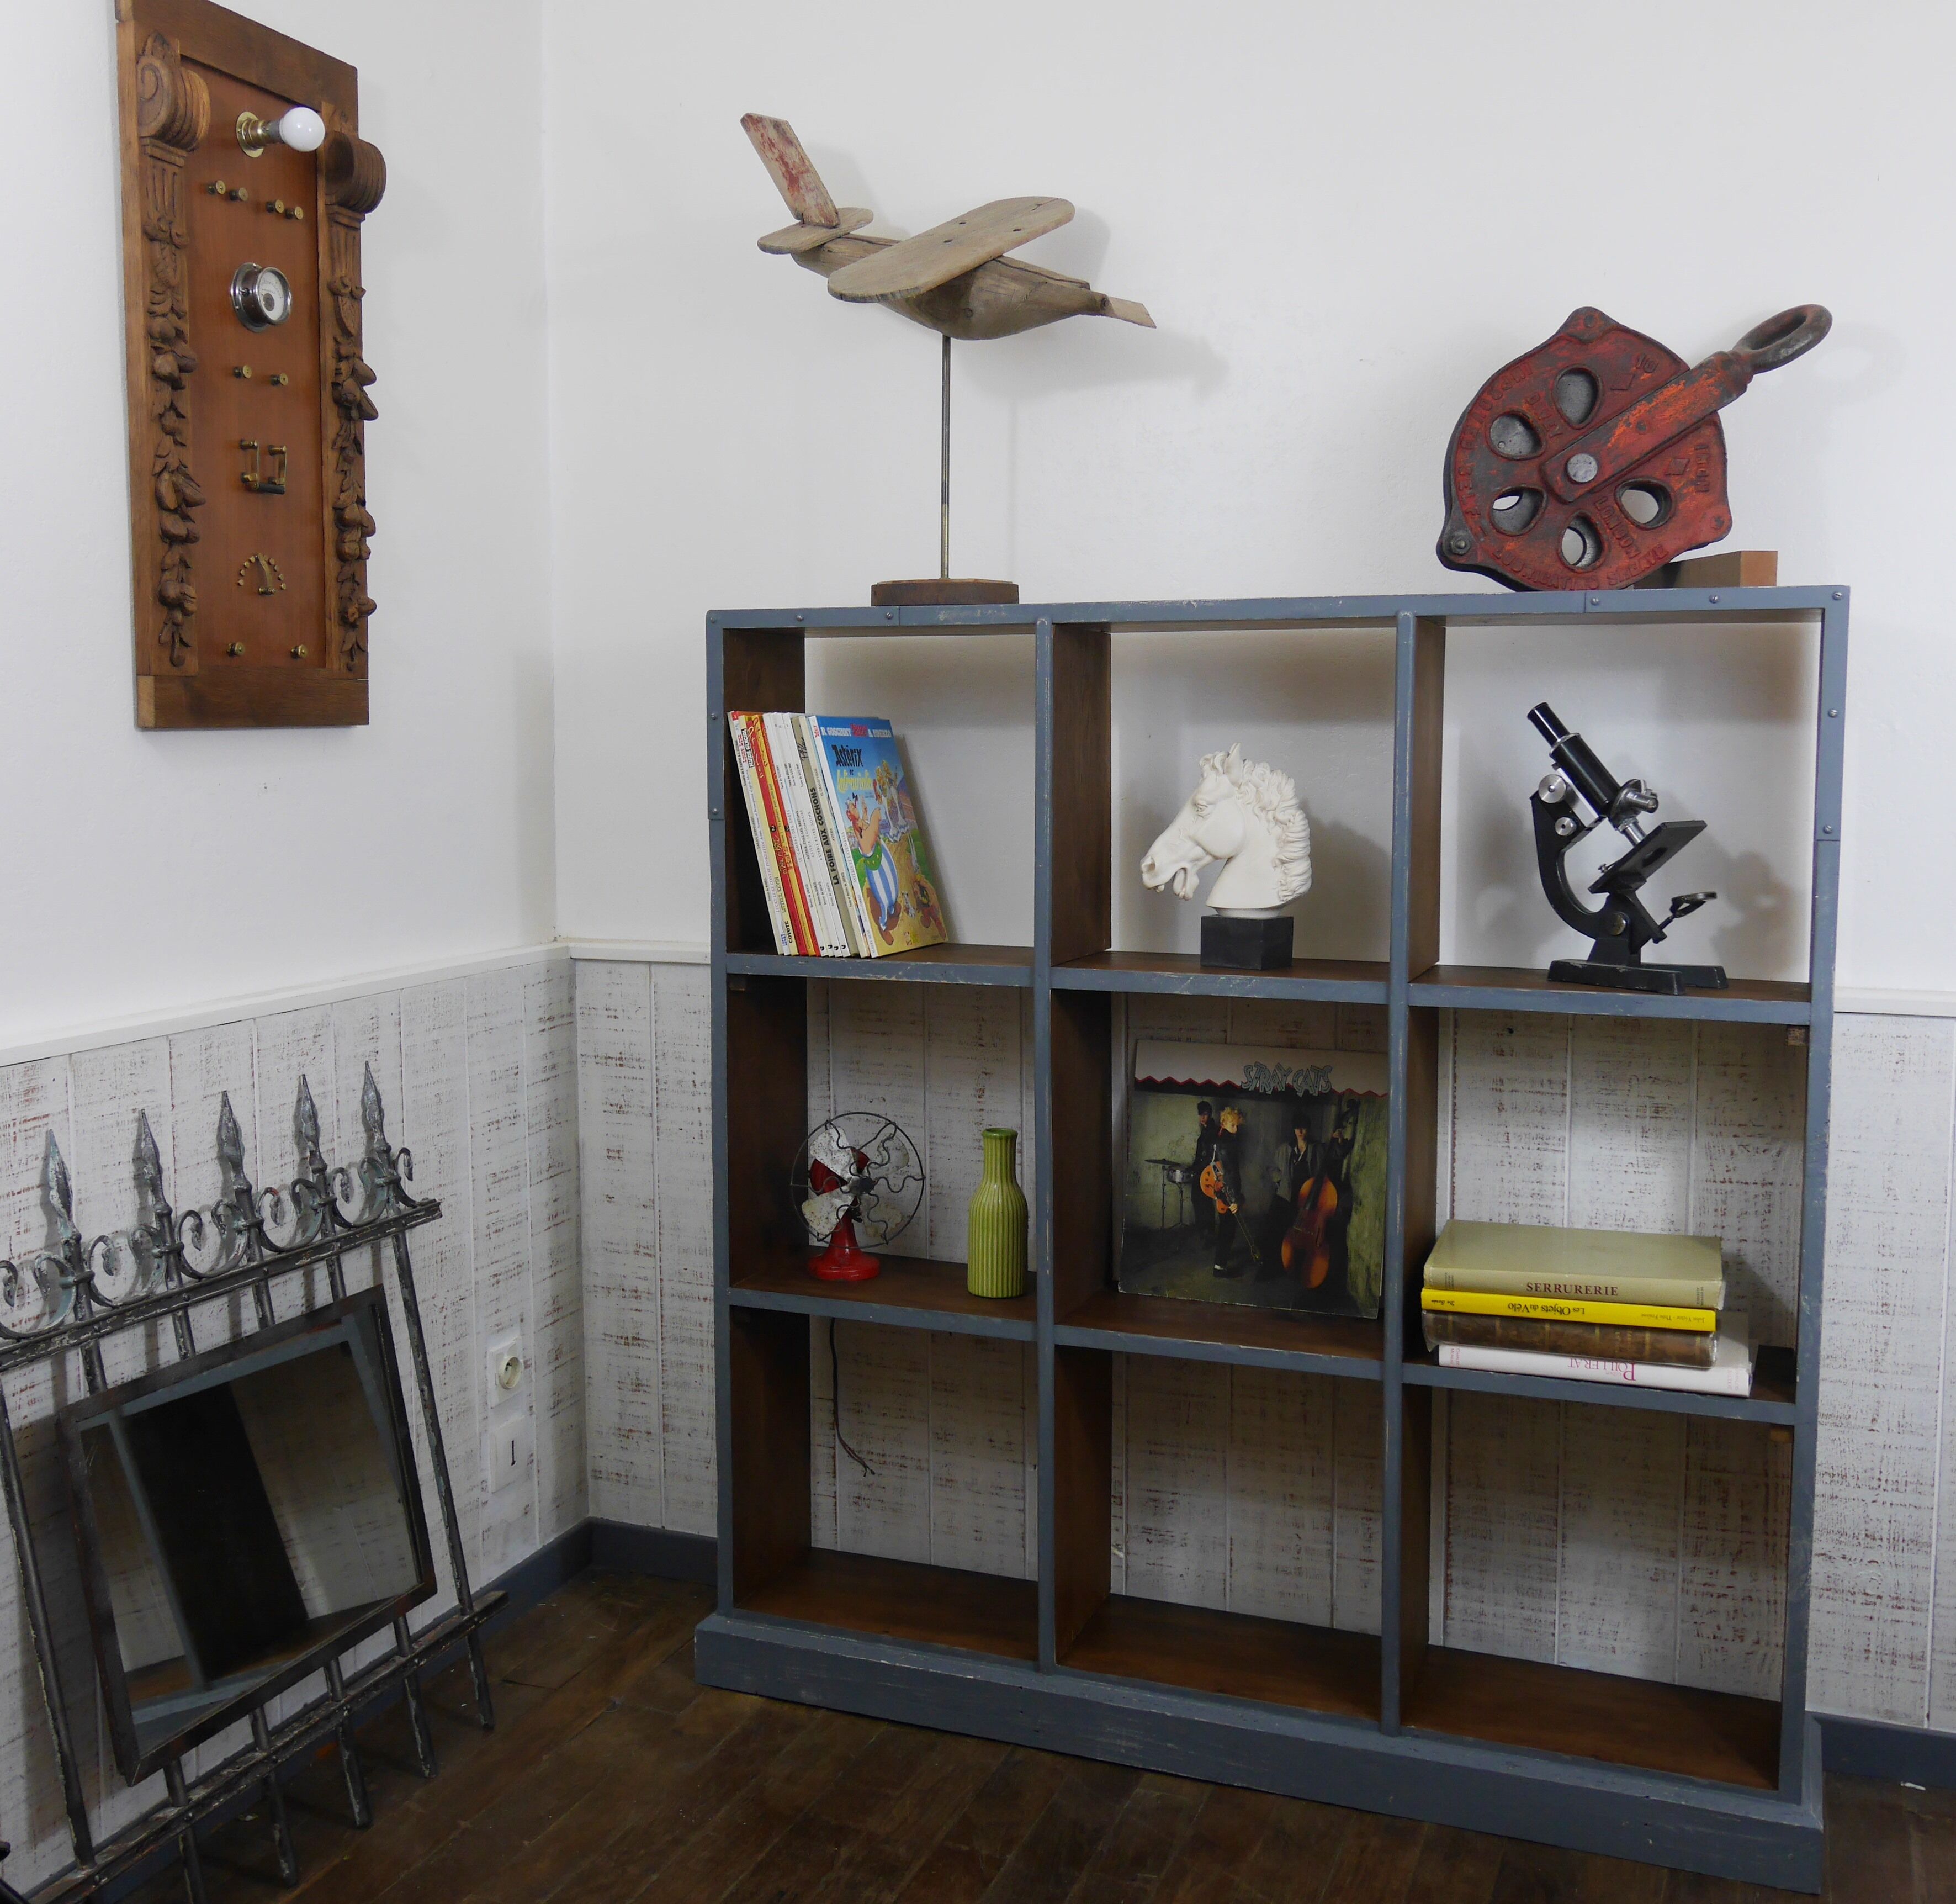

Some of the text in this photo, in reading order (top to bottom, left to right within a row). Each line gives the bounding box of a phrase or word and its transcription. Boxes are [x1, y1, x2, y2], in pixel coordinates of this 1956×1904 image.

[1595, 498, 1640, 559] LONDON
[741, 728, 750, 749] GLACIAL
[831, 744, 863, 767] Astérix
[809, 787, 839, 885] LA FOIRE AUX COCHONS
[784, 921, 792, 943] COYOTE
[1241, 1061, 1333, 1097] STRAY CATS
[1526, 1281, 1618, 1297] SERRURERIE
[1507, 1302, 1530, 1313] Vélo
[1540, 1302, 1571, 1315] Objets
